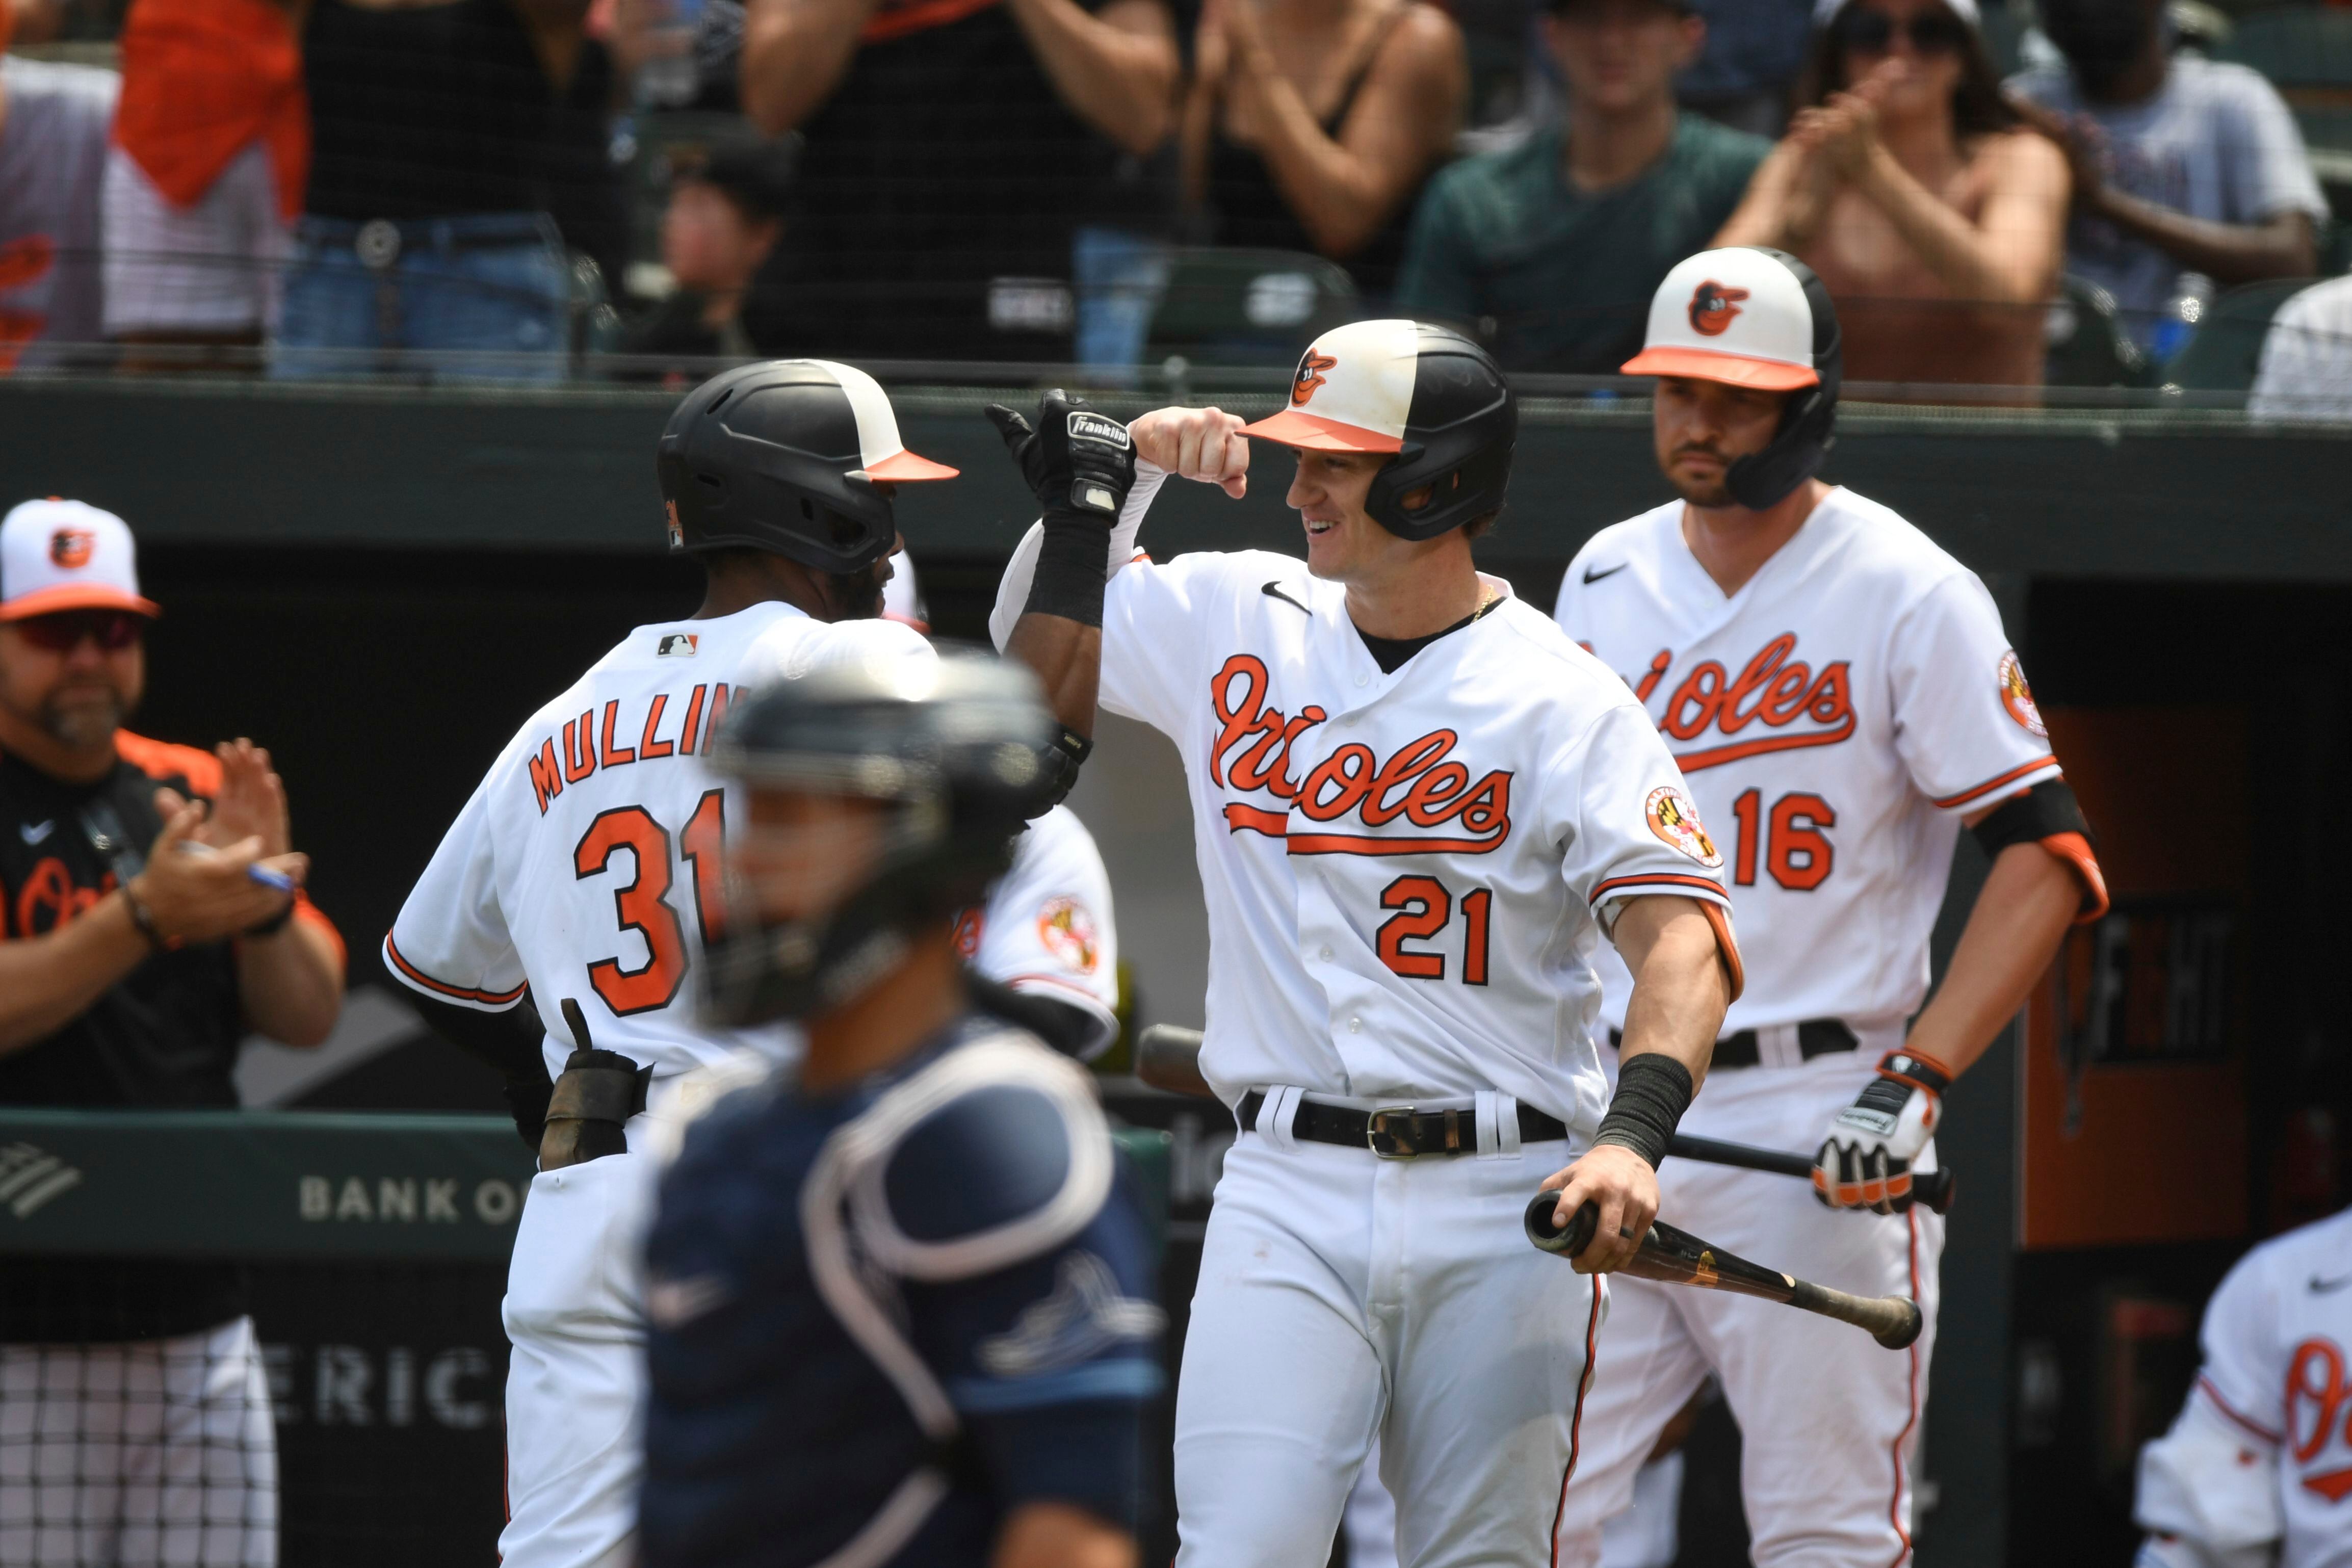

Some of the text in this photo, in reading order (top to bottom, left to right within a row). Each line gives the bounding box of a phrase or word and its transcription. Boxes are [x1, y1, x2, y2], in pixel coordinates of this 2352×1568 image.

[1210, 653, 1514, 855] Orioles
[1733, 787, 1837, 891] 16
[573, 788, 729, 1018] 31
[1375, 874, 1493, 987] 21
[300, 1175, 533, 1225] BANK O
